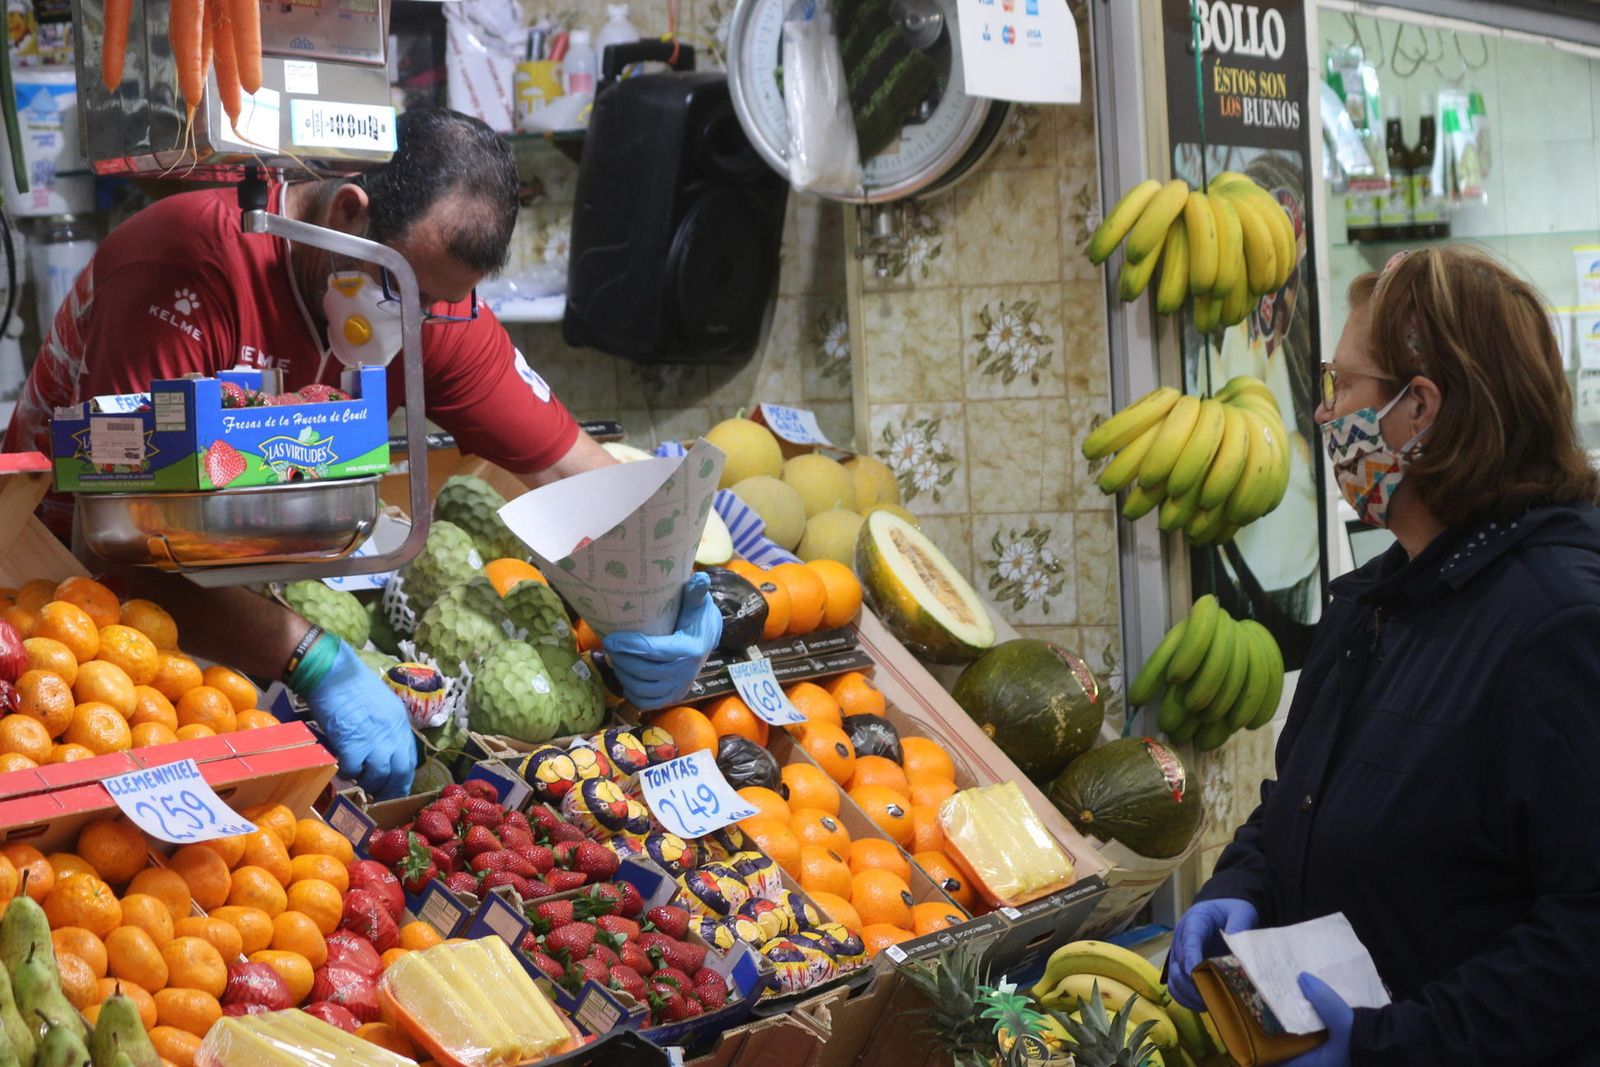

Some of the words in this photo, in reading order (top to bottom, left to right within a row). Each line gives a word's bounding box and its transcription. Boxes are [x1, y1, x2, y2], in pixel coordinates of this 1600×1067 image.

[1188, 0, 1286, 60] BOLLO
[1213, 57, 1257, 96] ÉSTOS
[1259, 71, 1287, 99] SON
[1220, 95, 1242, 118] LOS
[1242, 97, 1300, 130] BUENOS
[148, 304, 202, 341] KELME
[265, 416, 277, 427] de
[279, 415, 290, 427] la
[293, 412, 327, 425] Huerta
[329, 411, 341, 422] de
[342, 408, 368, 423] Conil
[269, 442, 286, 459] LAS
[285, 442, 328, 463] VIRTUDES
[106, 760, 200, 796] CLEMENMIEL
[644, 757, 699, 789] TONTAS
